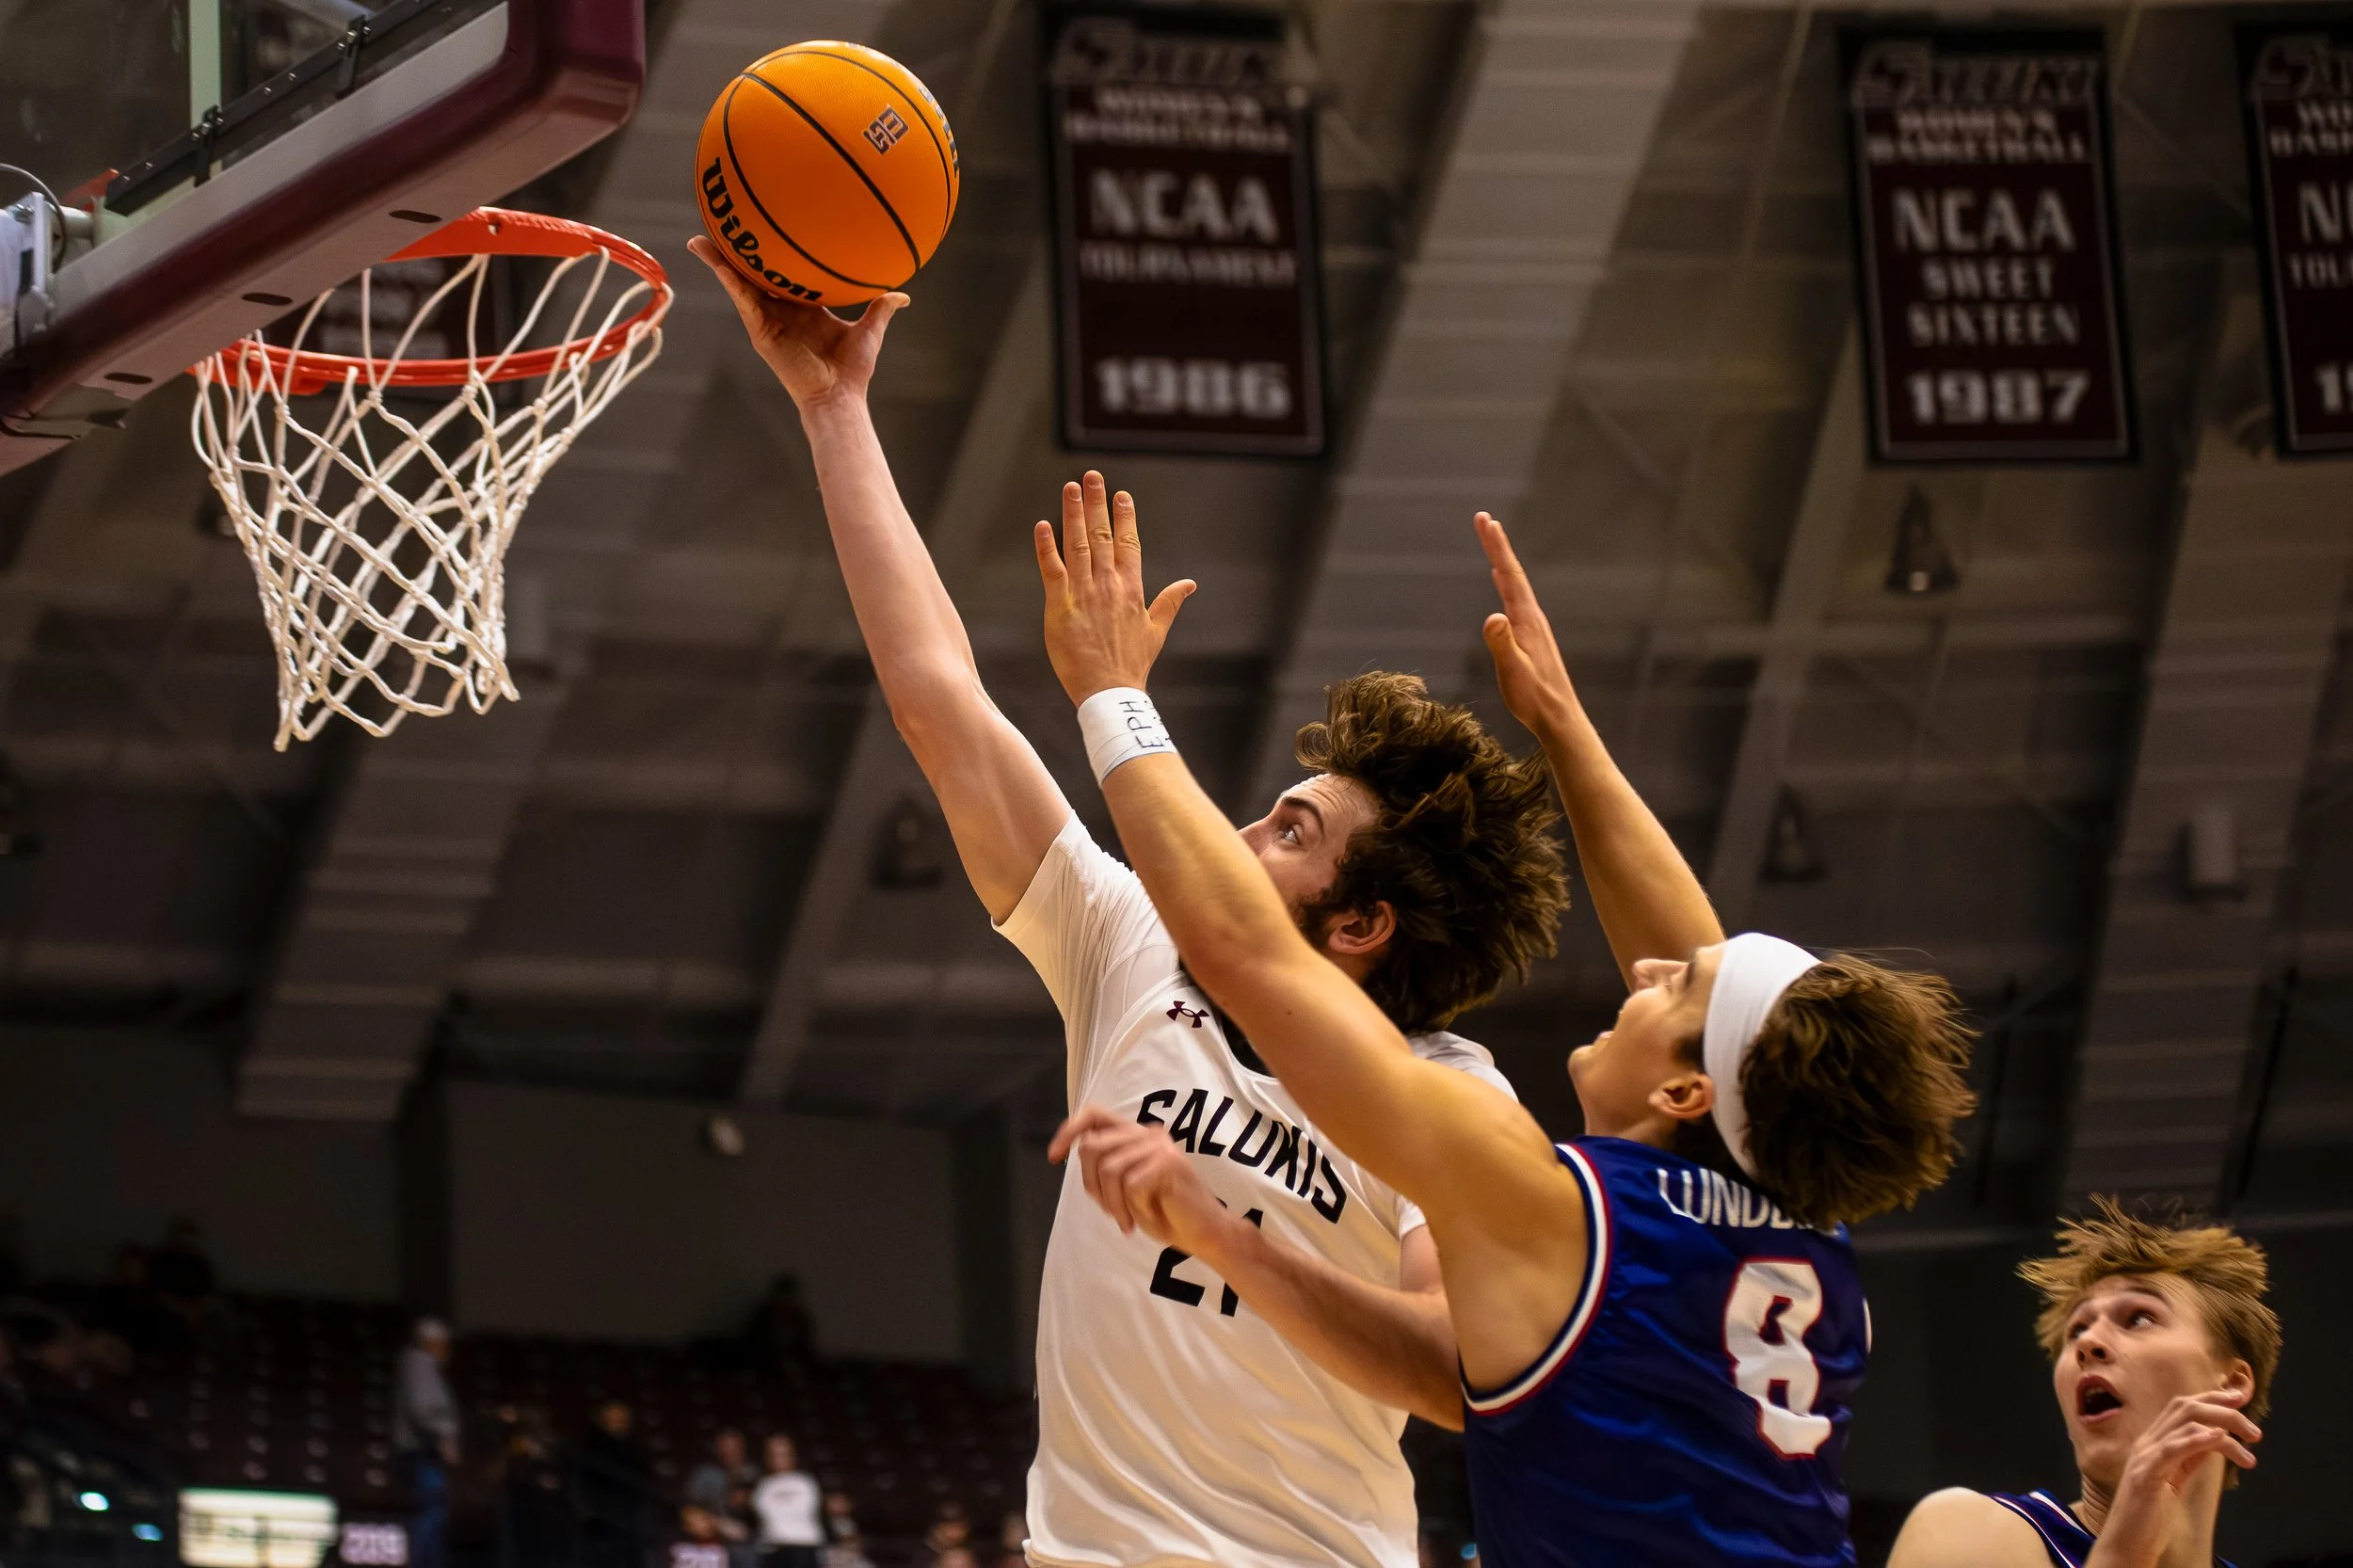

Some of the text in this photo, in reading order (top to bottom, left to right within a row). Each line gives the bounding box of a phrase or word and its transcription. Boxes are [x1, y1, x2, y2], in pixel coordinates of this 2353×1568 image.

[702, 155, 823, 302] Wilson
[1089, 168, 1280, 243] NCAA
[1891, 186, 2076, 253] NCAA
[1921, 255, 2056, 300] SWEET
[1906, 301, 2080, 347] SIXTEEN
[1097, 357, 1290, 419] 1986
[1904, 368, 2091, 426] 1987
[1722, 1255, 1833, 1461] 8
